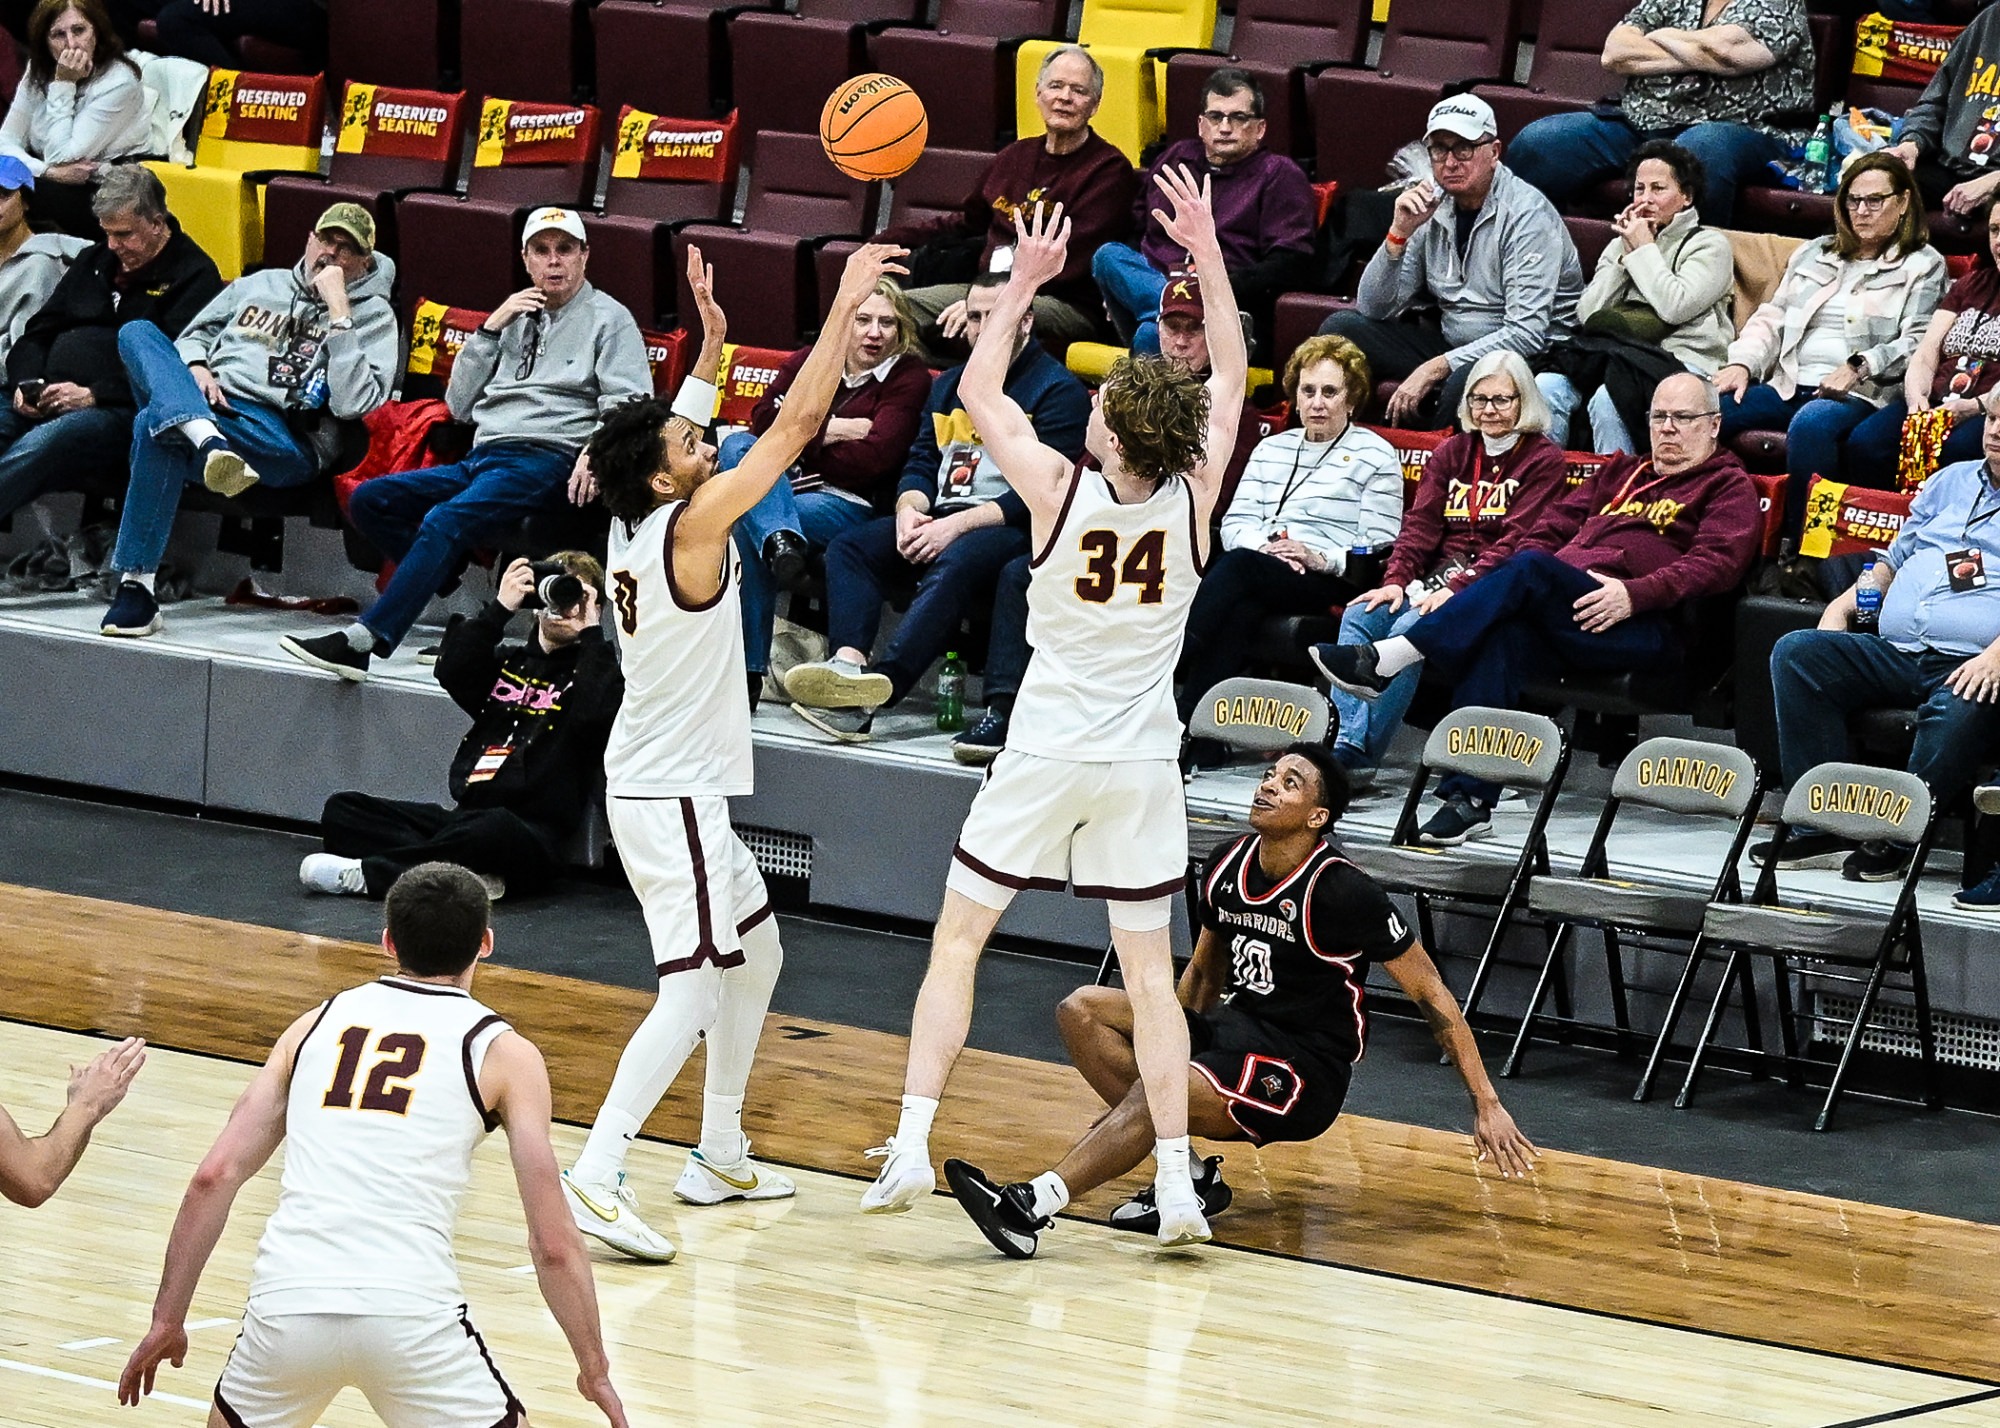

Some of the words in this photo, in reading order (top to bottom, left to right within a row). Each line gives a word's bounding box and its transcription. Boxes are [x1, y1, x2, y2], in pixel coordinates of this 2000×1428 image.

[236, 89, 307, 107] RESERVED
[839, 77, 903, 115] Wilson
[239, 106, 298, 121] SEATING
[374, 103, 448, 122] RESERVED
[510, 110, 585, 129] RESERVED
[378, 119, 438, 137] SEATING
[515, 125, 576, 142] SEATING
[648, 130, 723, 144] RESERVED
[654, 143, 714, 158] SEATING
[1074, 527, 1167, 605] 34
[1213, 697, 1311, 738] GANNON
[1448, 726, 1543, 767] GANNON
[1637, 757, 1737, 799] GANNON
[1808, 783, 1912, 827] GANNON
[1231, 933, 1275, 996] 10
[321, 1024, 429, 1118] 12
